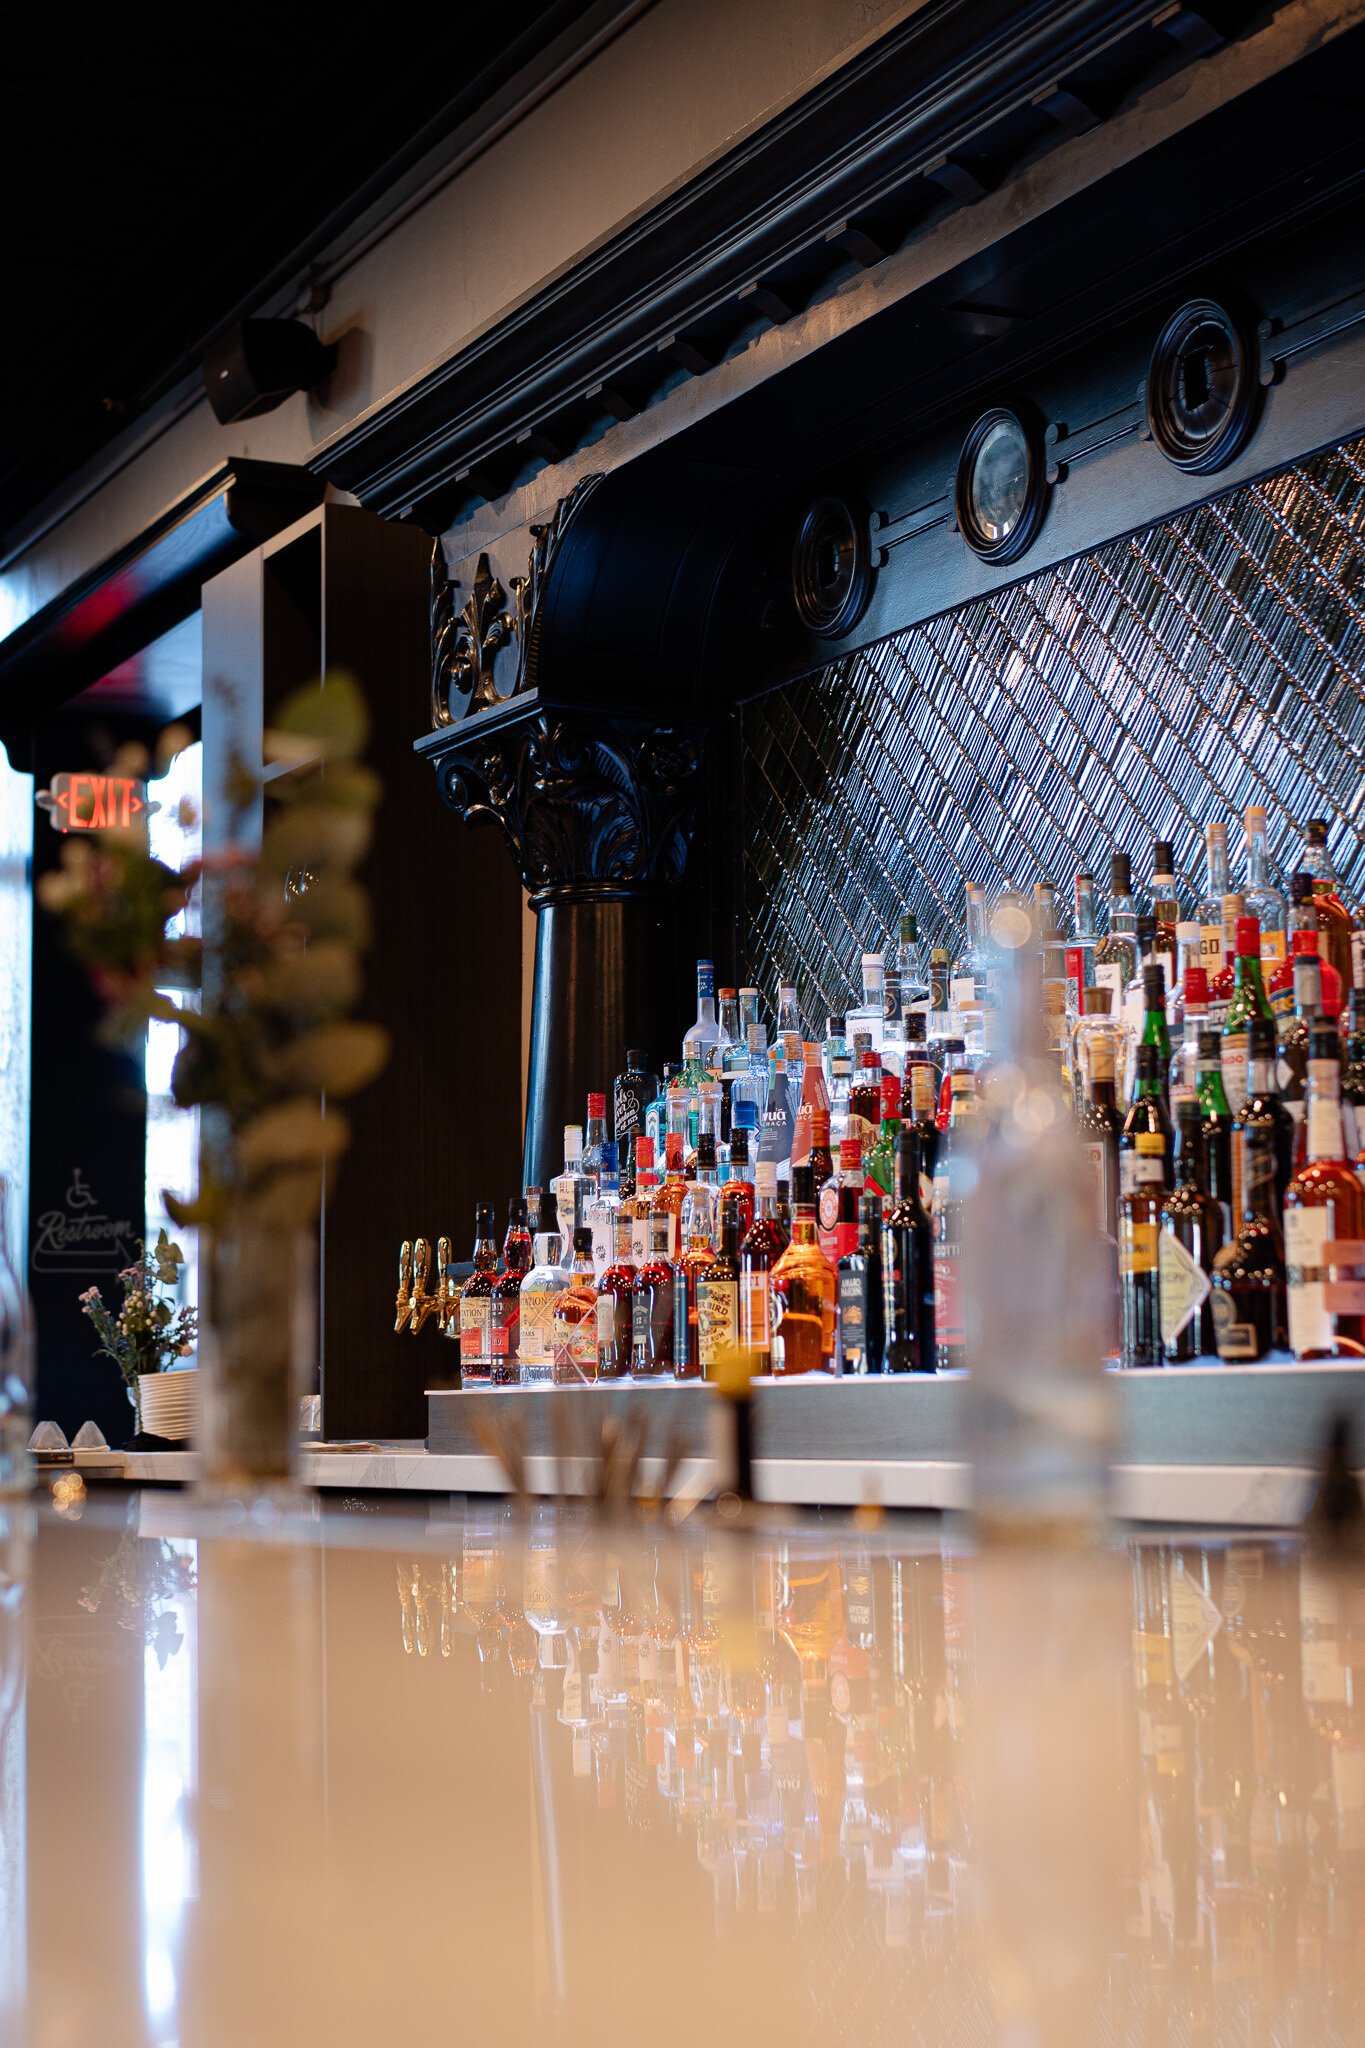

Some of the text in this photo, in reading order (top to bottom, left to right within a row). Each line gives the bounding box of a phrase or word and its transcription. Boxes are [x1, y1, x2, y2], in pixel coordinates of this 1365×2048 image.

[69, 773, 136, 828] EXIT
[34, 1211, 136, 1250] Restroom
[707, 1302, 729, 1316] BIRD
